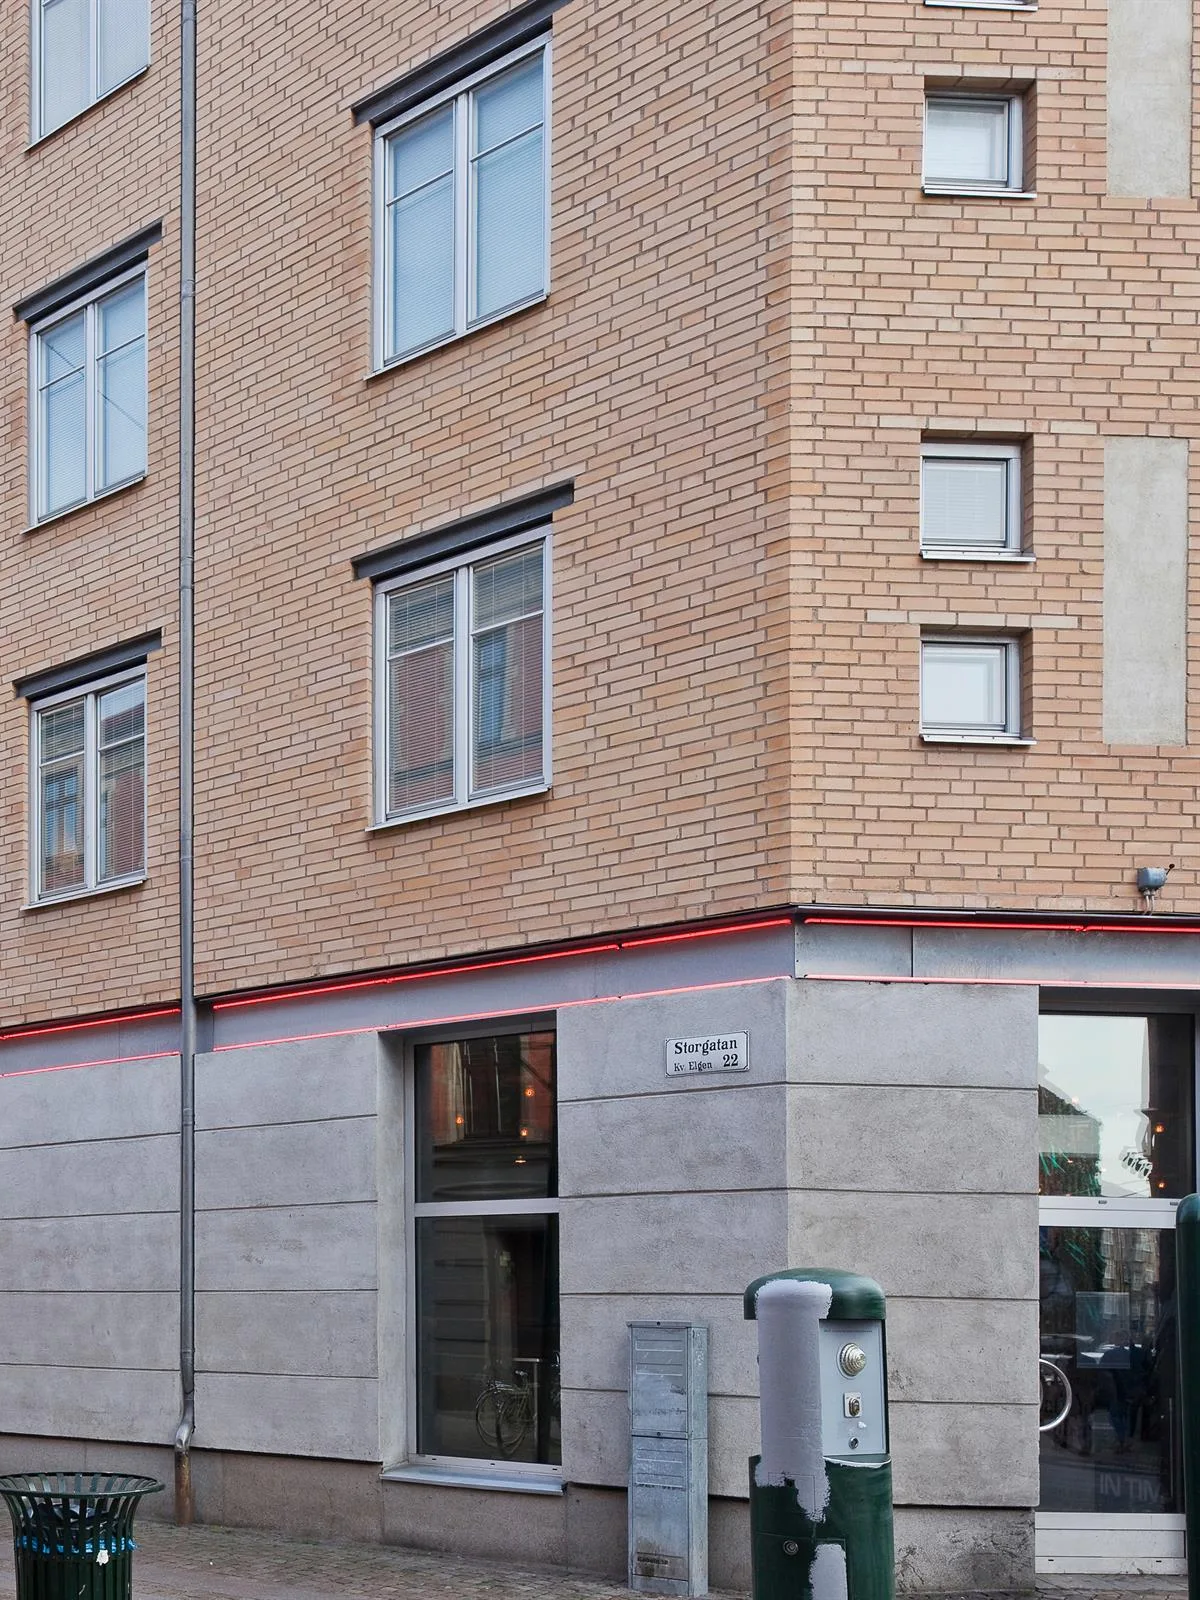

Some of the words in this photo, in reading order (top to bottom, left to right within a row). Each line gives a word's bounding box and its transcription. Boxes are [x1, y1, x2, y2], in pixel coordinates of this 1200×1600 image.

[674, 1039, 738, 1056] Storgatan
[688, 1061, 712, 1072] Elgen
[722, 1054, 738, 1068] 22
